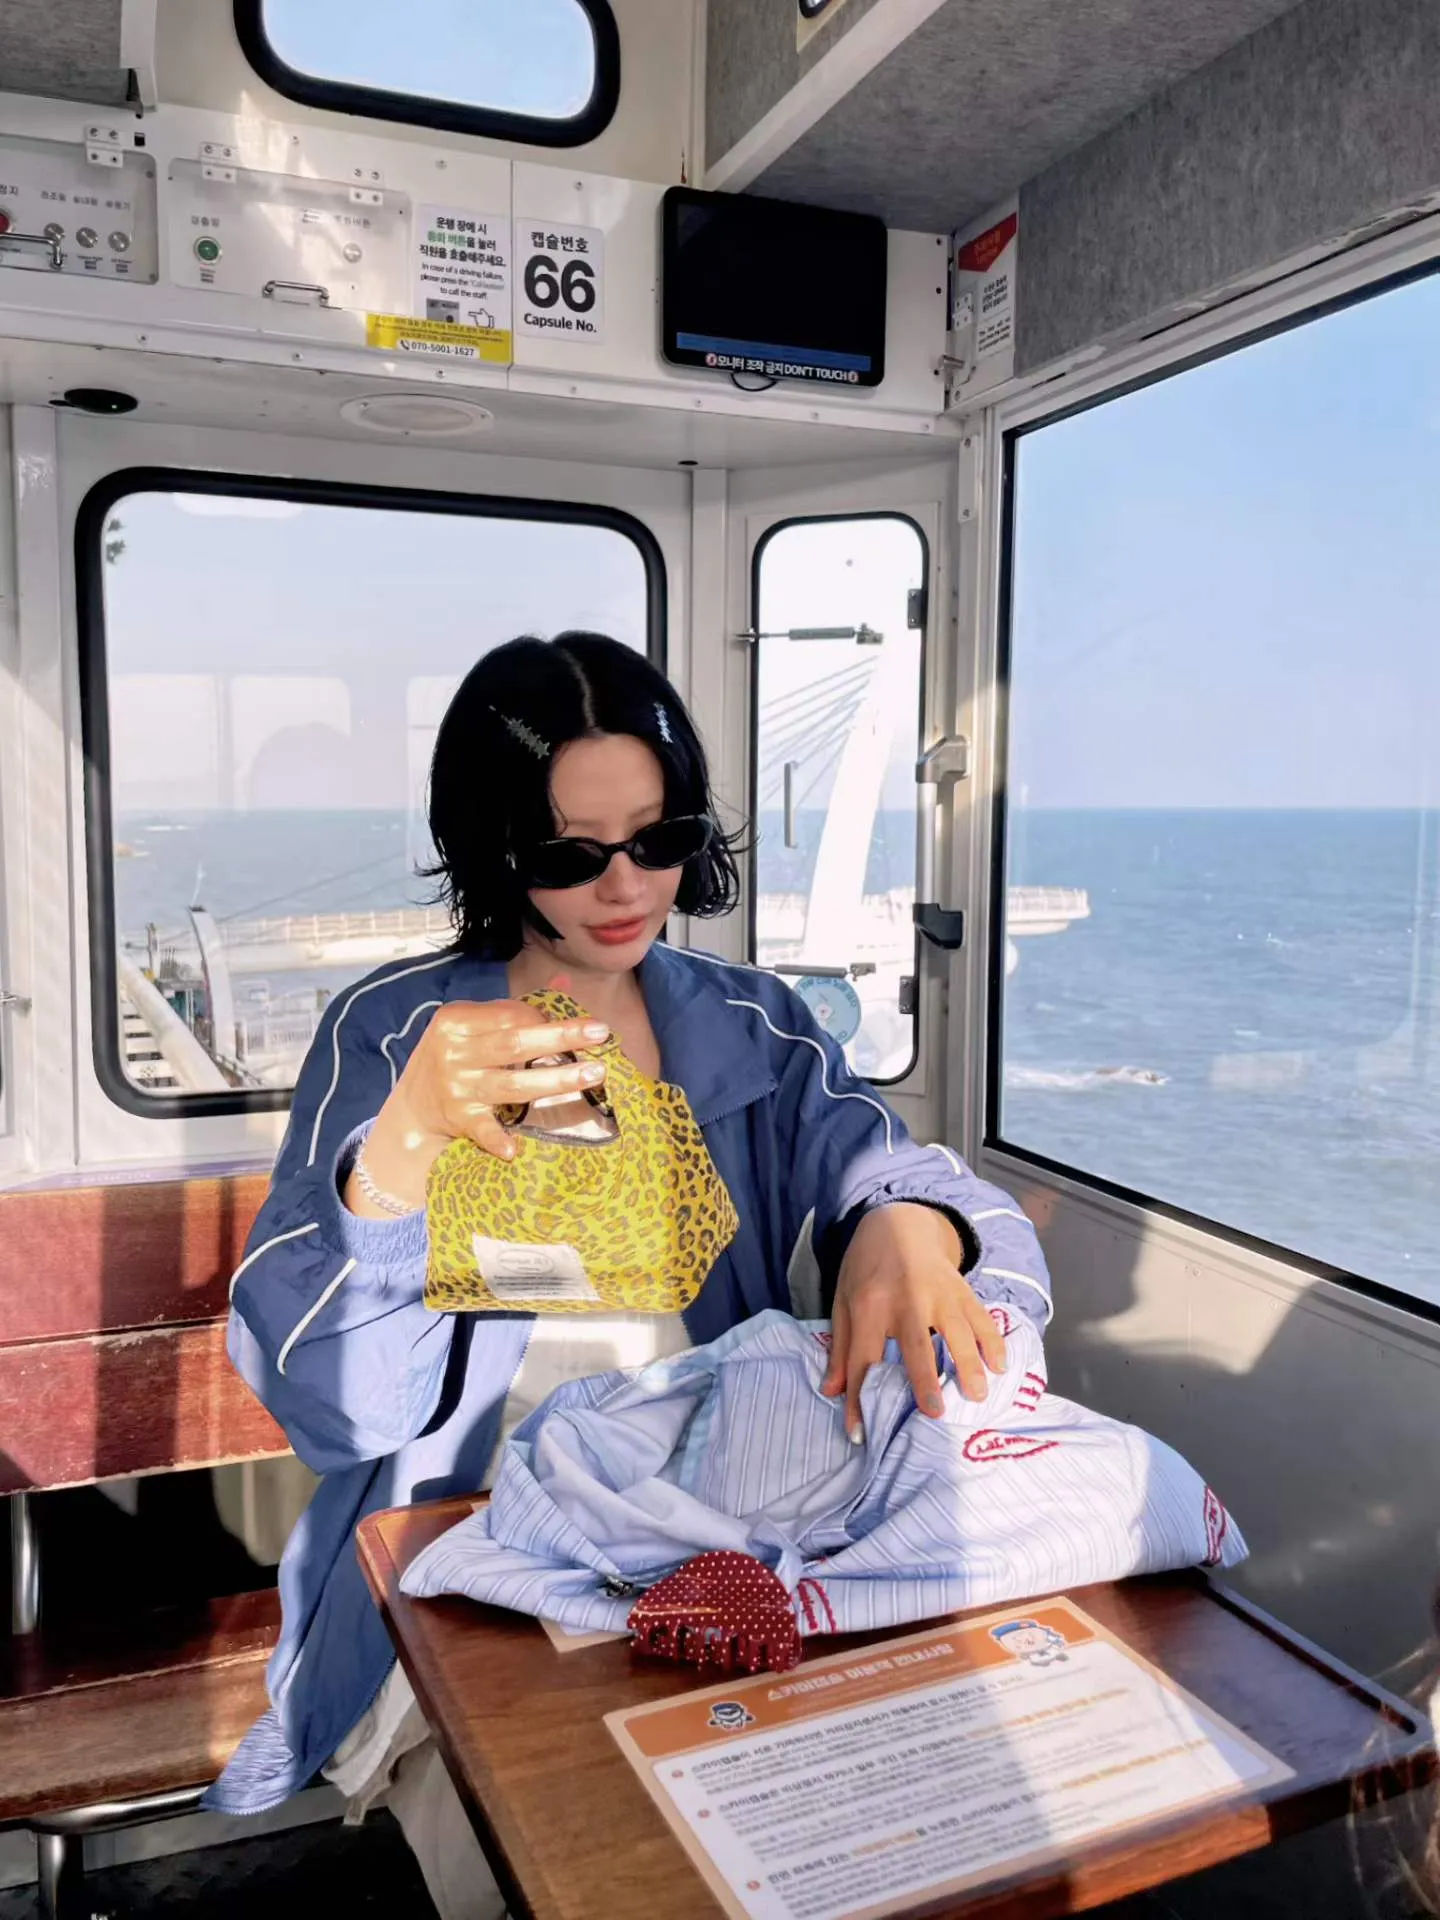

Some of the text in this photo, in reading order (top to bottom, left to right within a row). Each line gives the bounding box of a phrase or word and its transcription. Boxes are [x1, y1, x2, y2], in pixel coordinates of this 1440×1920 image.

[477, 223, 487, 236] 시
[531, 231, 590, 254] 캡슐번호
[524, 254, 596, 313] 66
[523, 312, 573, 330] Capsule
[576, 319, 597, 334] No.
[717, 354, 848, 381] 모니터 조작 금지 DON'T TOUCH
